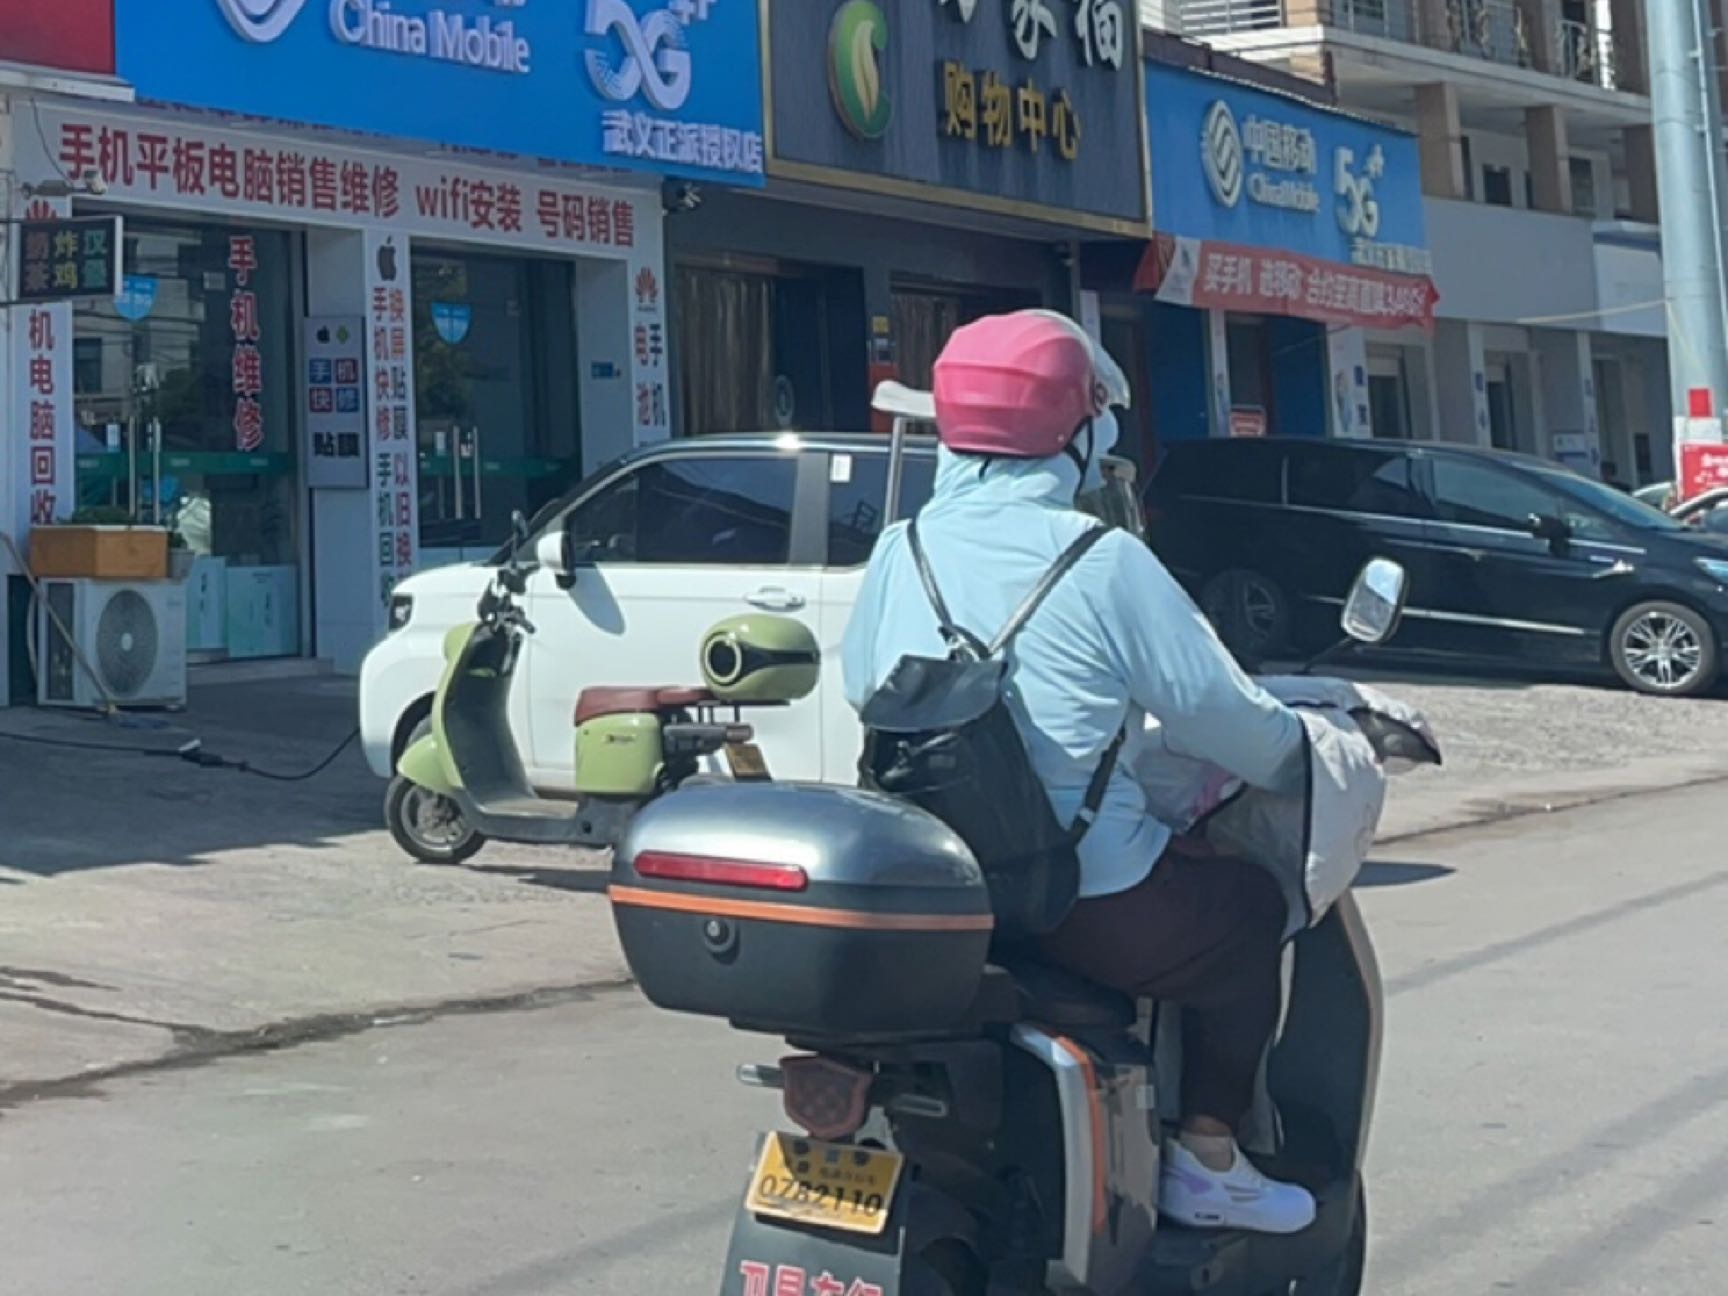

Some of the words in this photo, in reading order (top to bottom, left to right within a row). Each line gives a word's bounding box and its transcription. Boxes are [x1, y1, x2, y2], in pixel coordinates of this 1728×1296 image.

[429, 10, 531, 73] Mobile
[601, 109, 763, 173] 武义正派授权店
[944, 60, 1083, 160] 购物中心
[1241, 114, 1318, 176] 中国移动
[59, 123, 400, 220] 手机平板电脑销售维修
[416, 178, 524, 234] wifi安装
[536, 195, 635, 248] 号码销售
[228, 234, 264, 453] 手机维修
